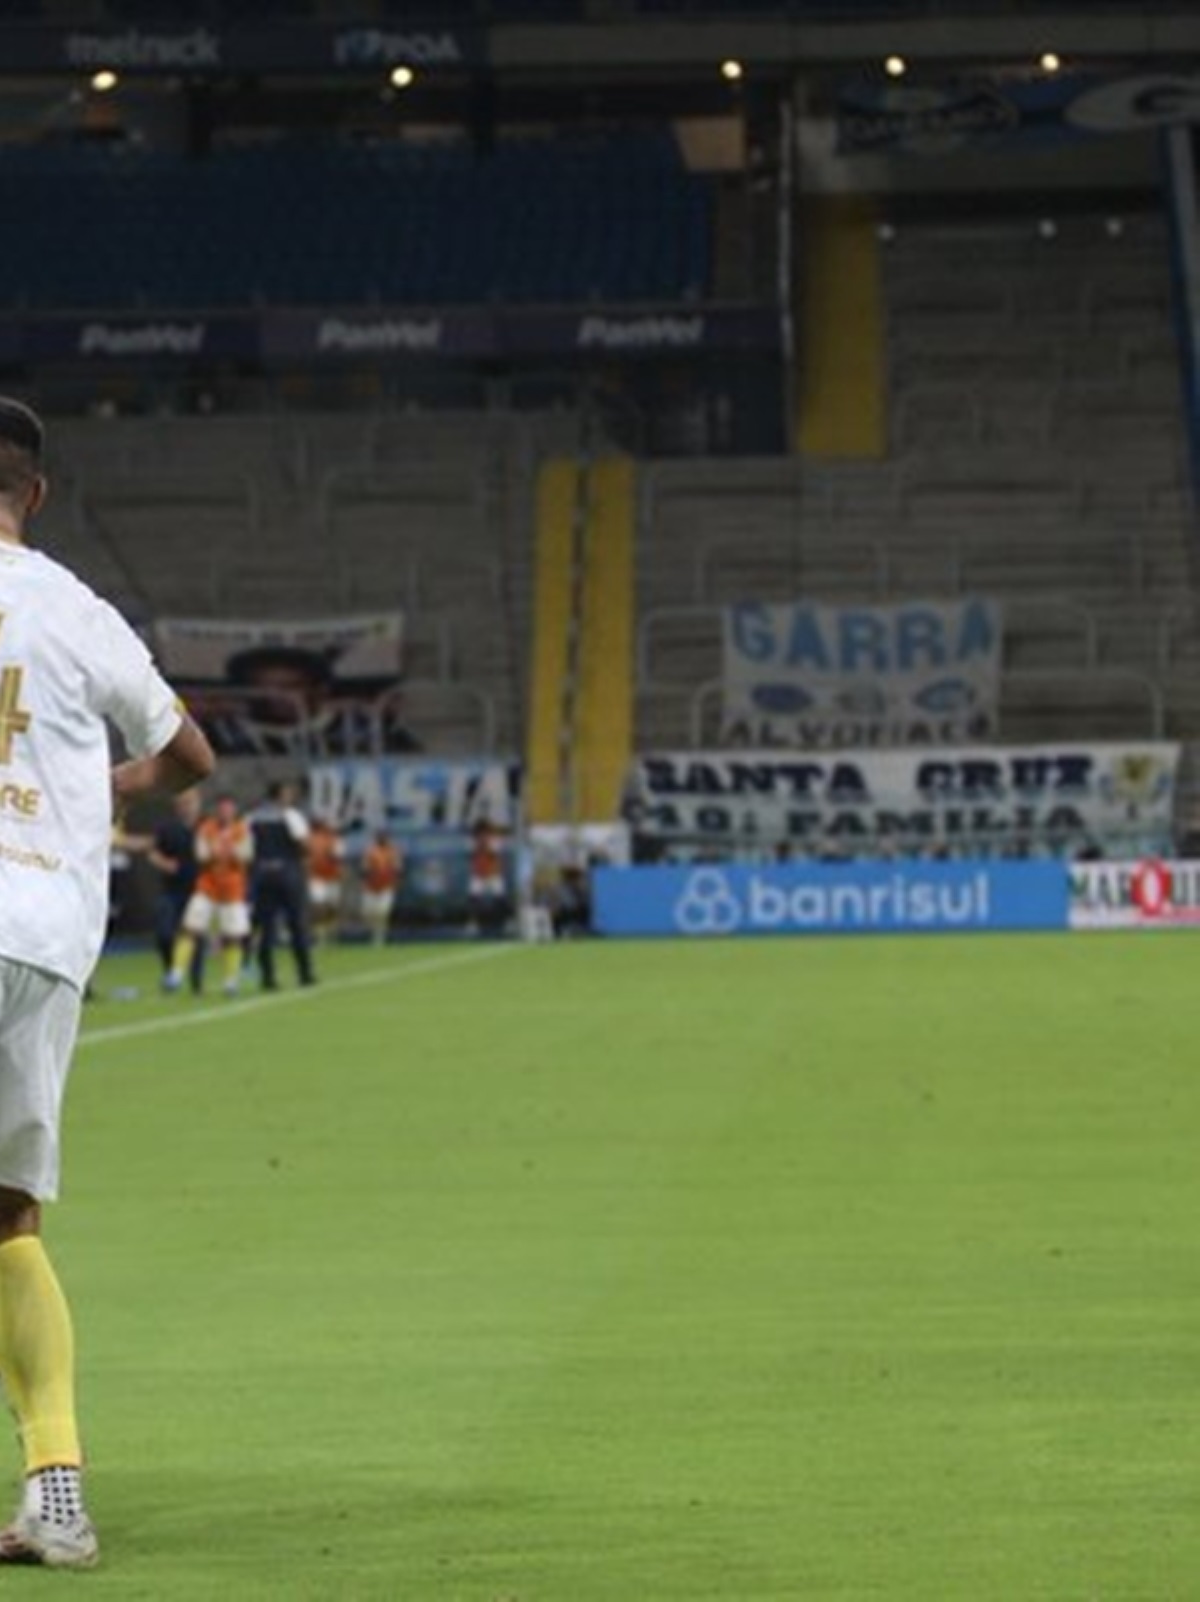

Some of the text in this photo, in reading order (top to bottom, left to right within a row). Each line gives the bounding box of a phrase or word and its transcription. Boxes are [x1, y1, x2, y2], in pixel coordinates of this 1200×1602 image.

[64, 26, 220, 65] melnick
[728, 597, 996, 673] GARRA
[644, 754, 1092, 798] SANTA CRUZ
[785, 806, 1086, 837] FAMILIA
[749, 872, 990, 922] banrisul
